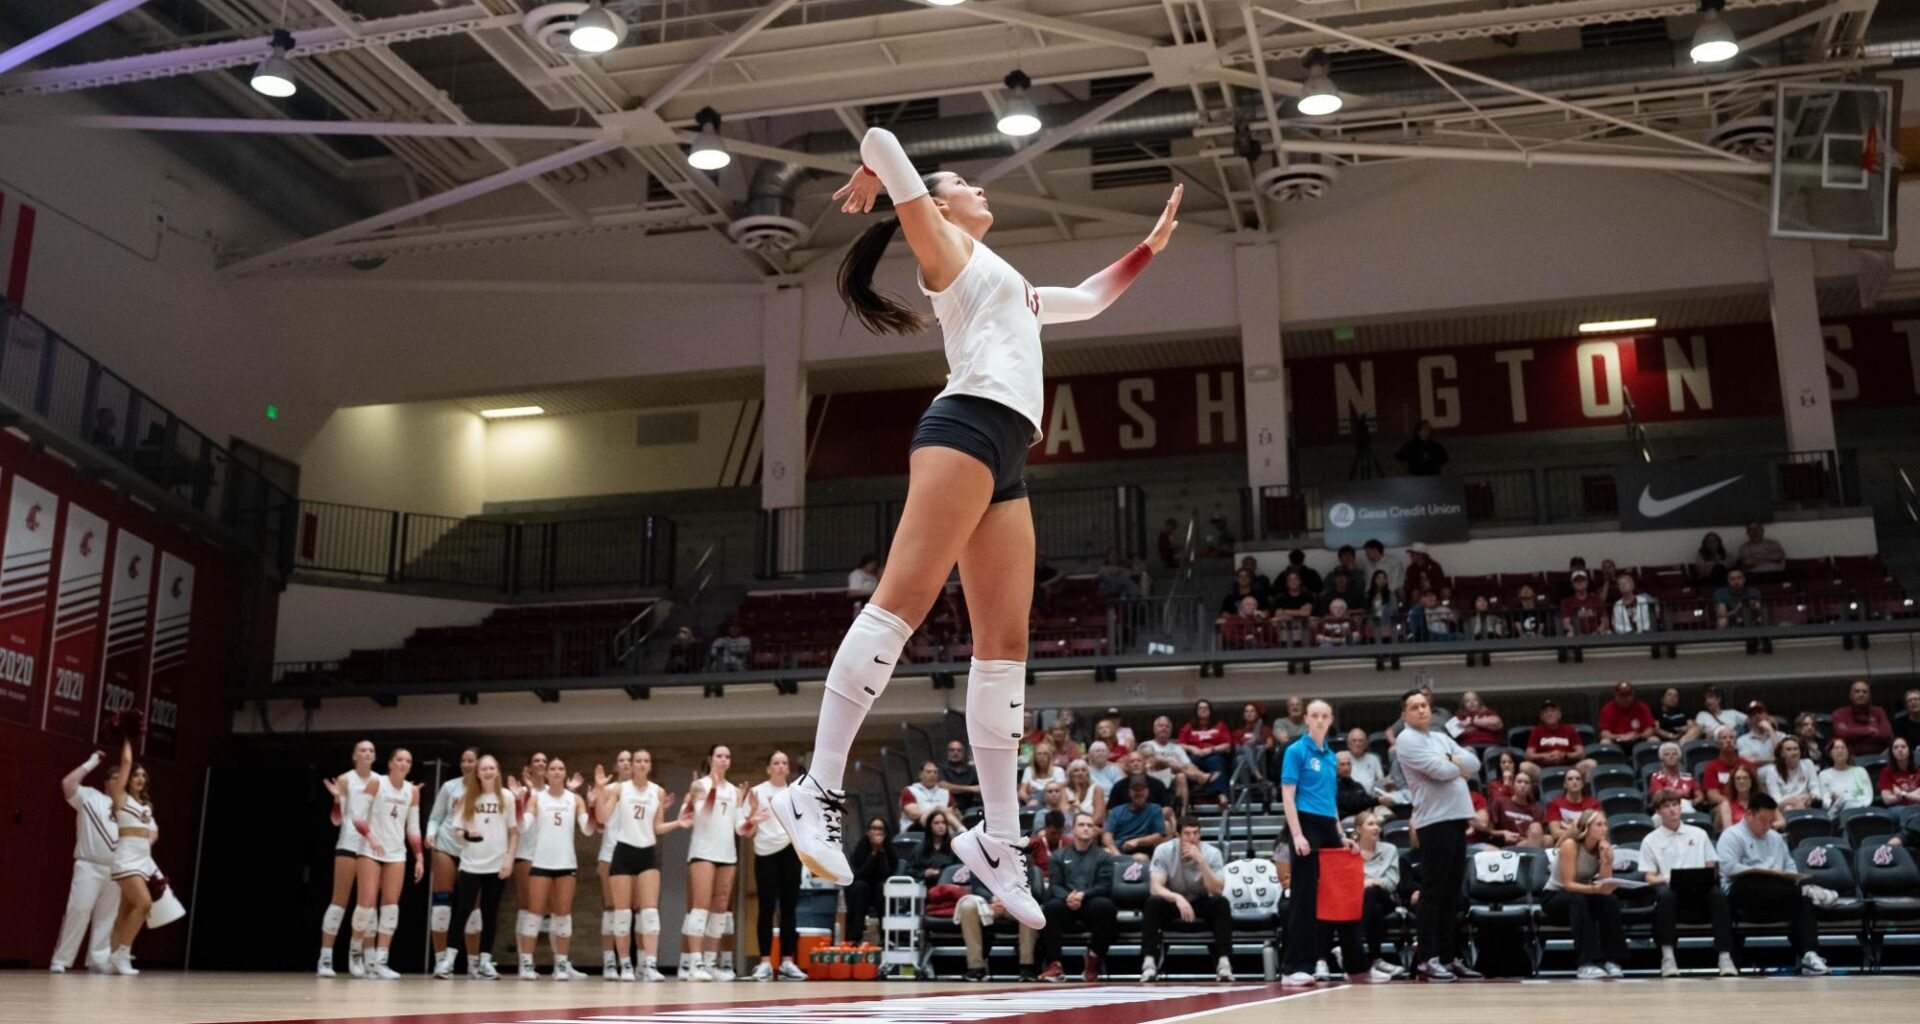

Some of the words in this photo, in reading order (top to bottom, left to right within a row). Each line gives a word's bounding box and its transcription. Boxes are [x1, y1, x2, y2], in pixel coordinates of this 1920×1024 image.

[1023, 279, 1040, 317] 13
[1045, 334, 1713, 457] ASHNGTON
[1389, 504, 1426, 517] Credit
[1427, 503, 1461, 516] Union
[0, 648, 34, 687] 2020
[55, 667, 84, 701] 2021
[389, 805, 399, 819] 4
[634, 805, 645, 820] 21
[720, 801, 728, 816] 7
[553, 812, 562, 826] 5
